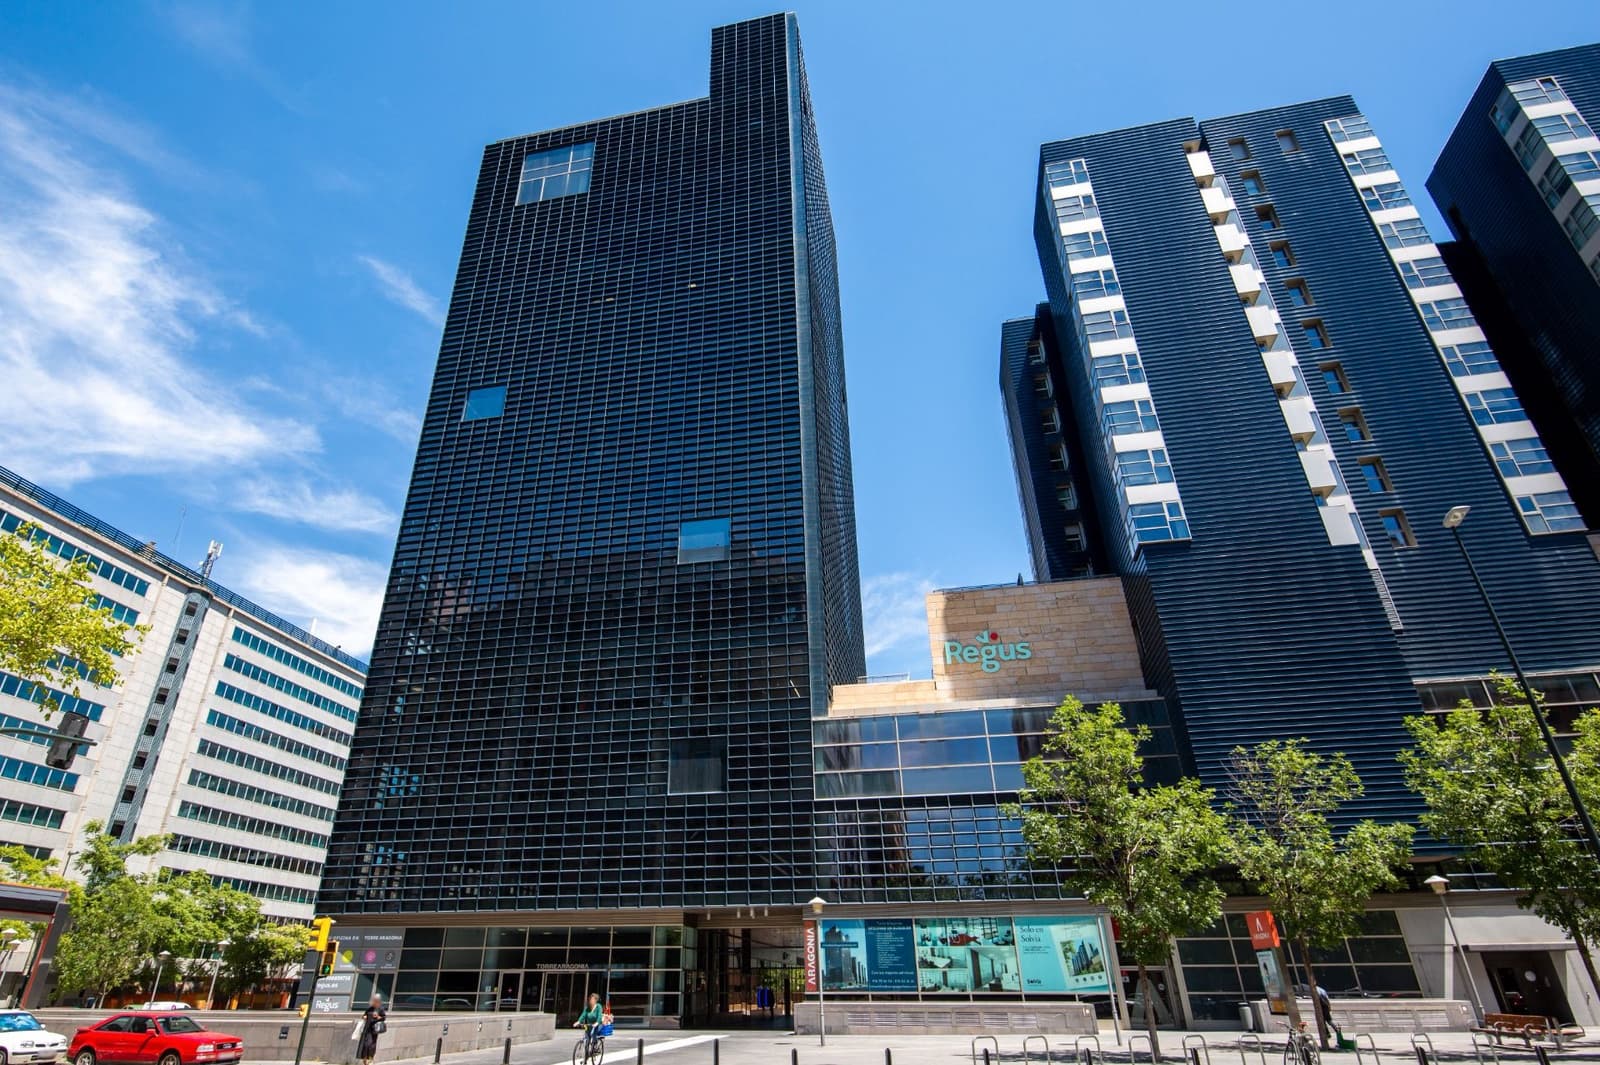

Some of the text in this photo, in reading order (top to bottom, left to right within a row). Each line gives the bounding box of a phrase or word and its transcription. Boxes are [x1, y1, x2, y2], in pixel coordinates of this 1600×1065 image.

[944, 641, 1032, 673] Regus
[1020, 925, 1034, 934] Solo
[1020, 934, 1041, 943] Solvia
[806, 927, 816, 985] ARAGONIA
[315, 1000, 339, 1012] Regus
